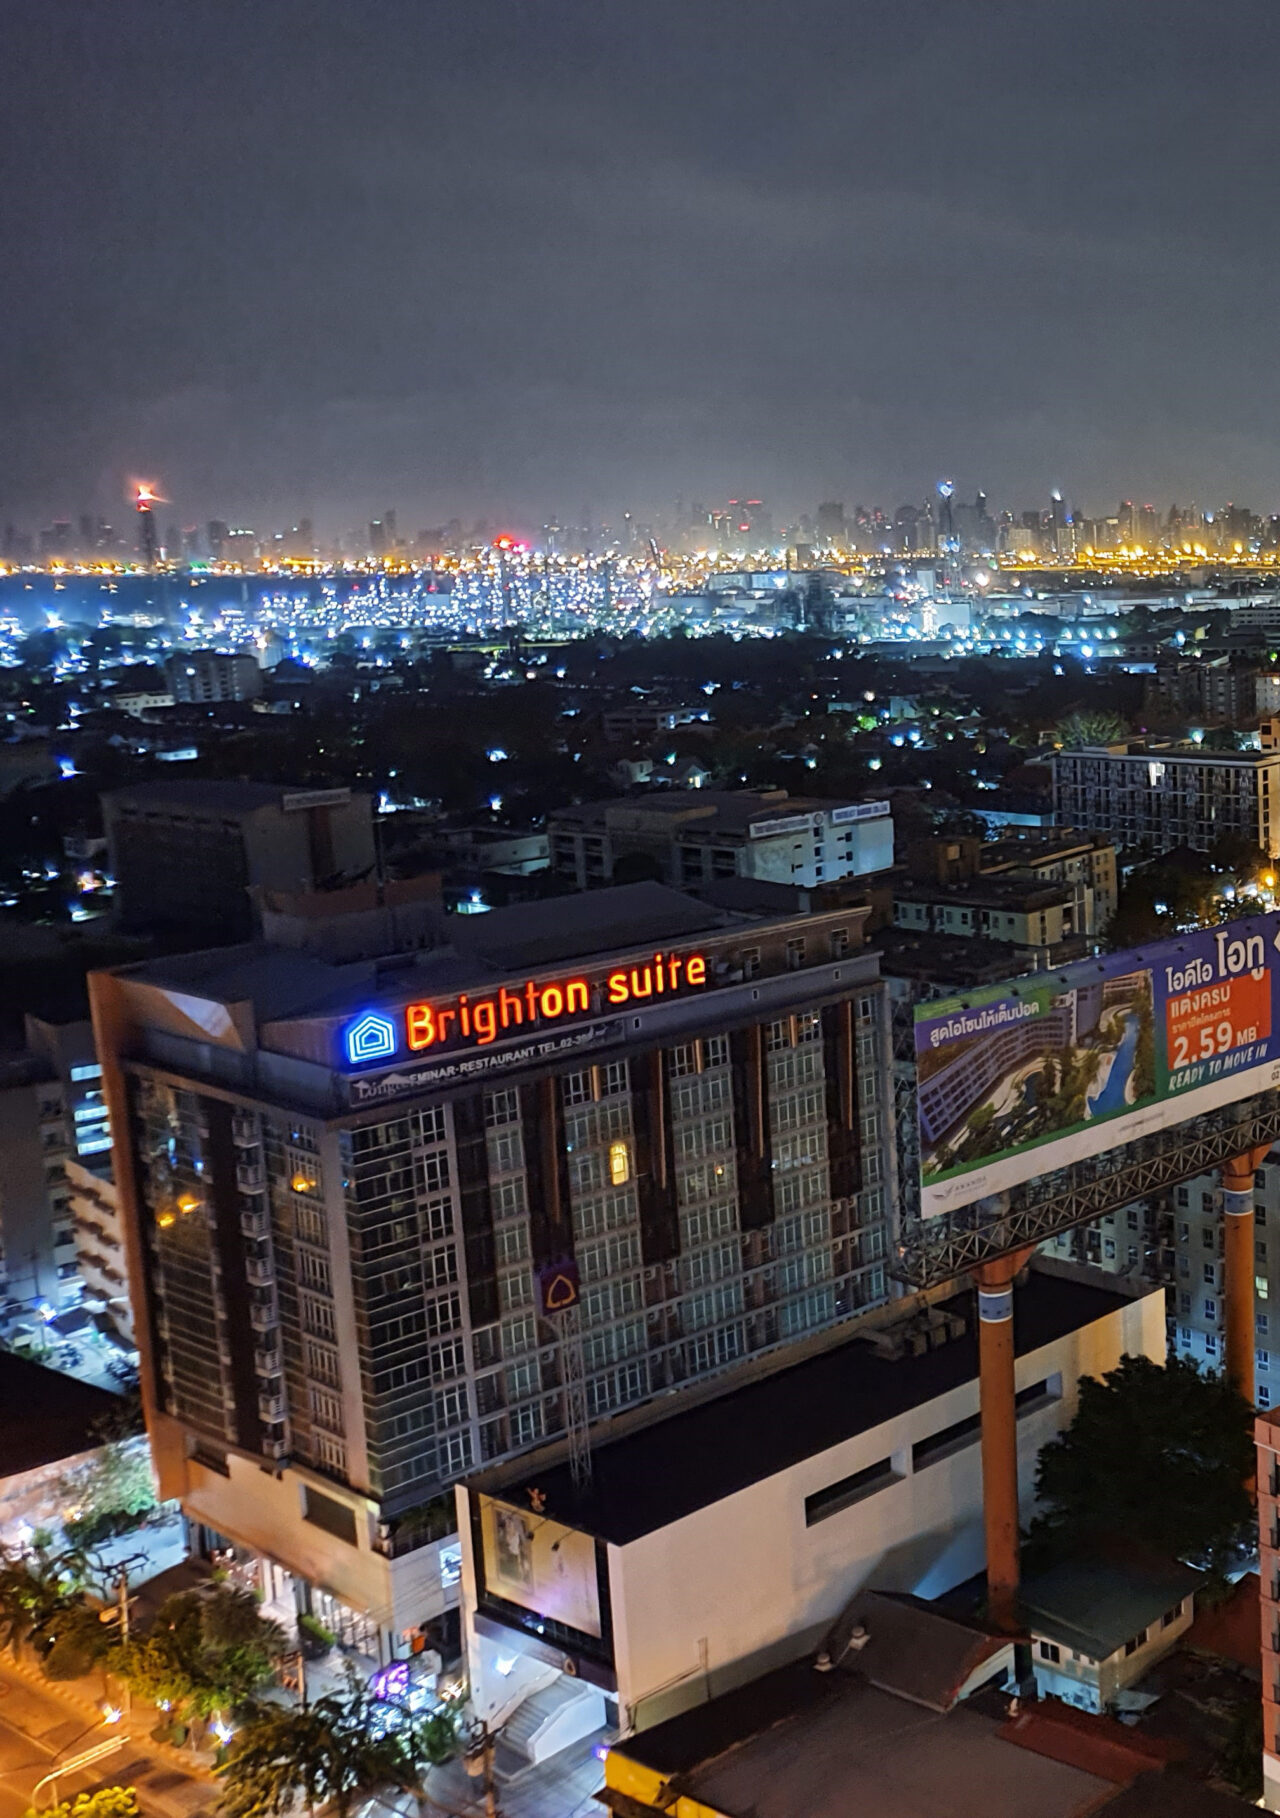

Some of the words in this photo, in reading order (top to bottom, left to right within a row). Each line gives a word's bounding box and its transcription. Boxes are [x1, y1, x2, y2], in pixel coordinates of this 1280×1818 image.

[1165, 958, 1213, 993] ไอดีโอ
[1215, 931, 1265, 981] โอทู
[405, 981, 589, 1050] Brighton
[608, 953, 706, 1003] suite
[1168, 1065, 1205, 1091] READY
[1208, 1060, 1222, 1076] TO
[1223, 1046, 1254, 1070] MOVE
[1255, 1043, 1268, 1060] IN
[1173, 1021, 1233, 1070] 2.59
